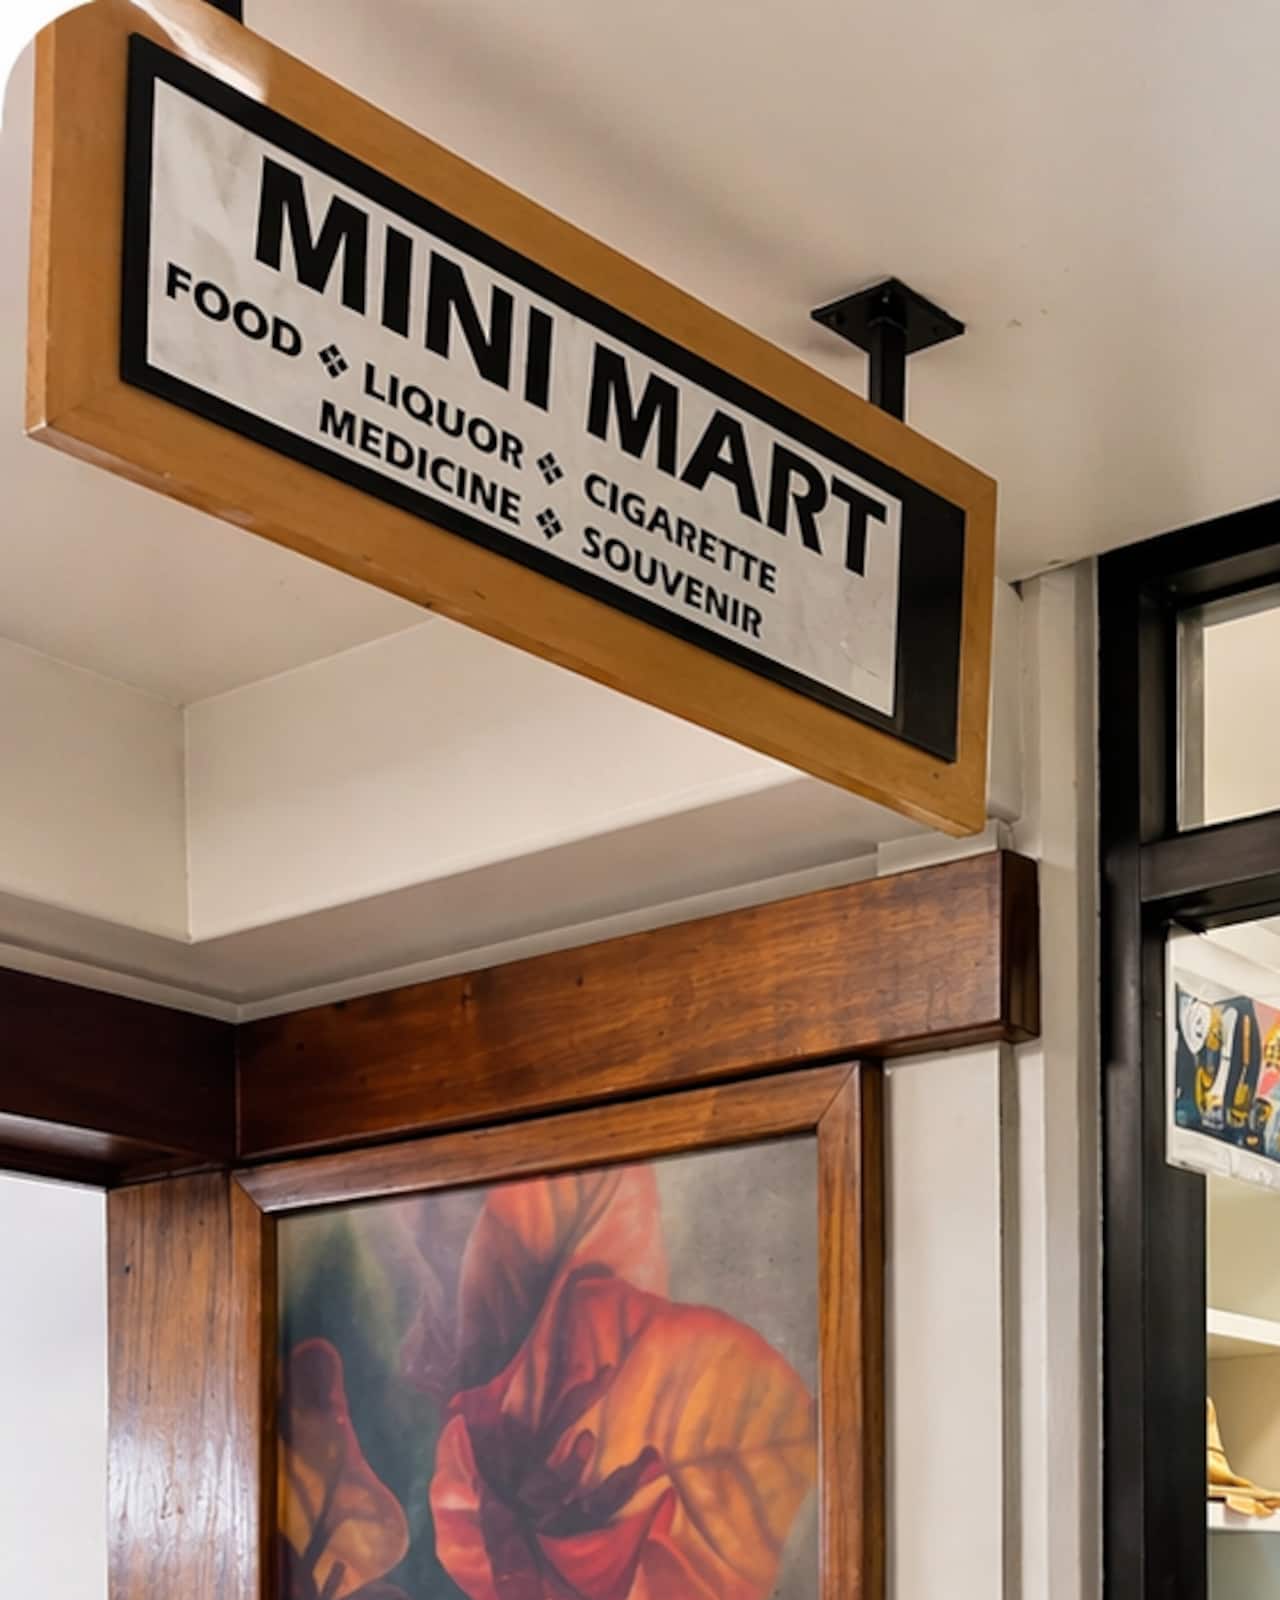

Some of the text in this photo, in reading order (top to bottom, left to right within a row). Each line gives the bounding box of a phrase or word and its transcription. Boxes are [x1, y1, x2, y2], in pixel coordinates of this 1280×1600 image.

[166, 263, 777, 593] FOOD LIQUOR CIGARETTE
[256, 157, 888, 577] MINI MART
[319, 400, 762, 638] MEDICINE SOUVENIR
